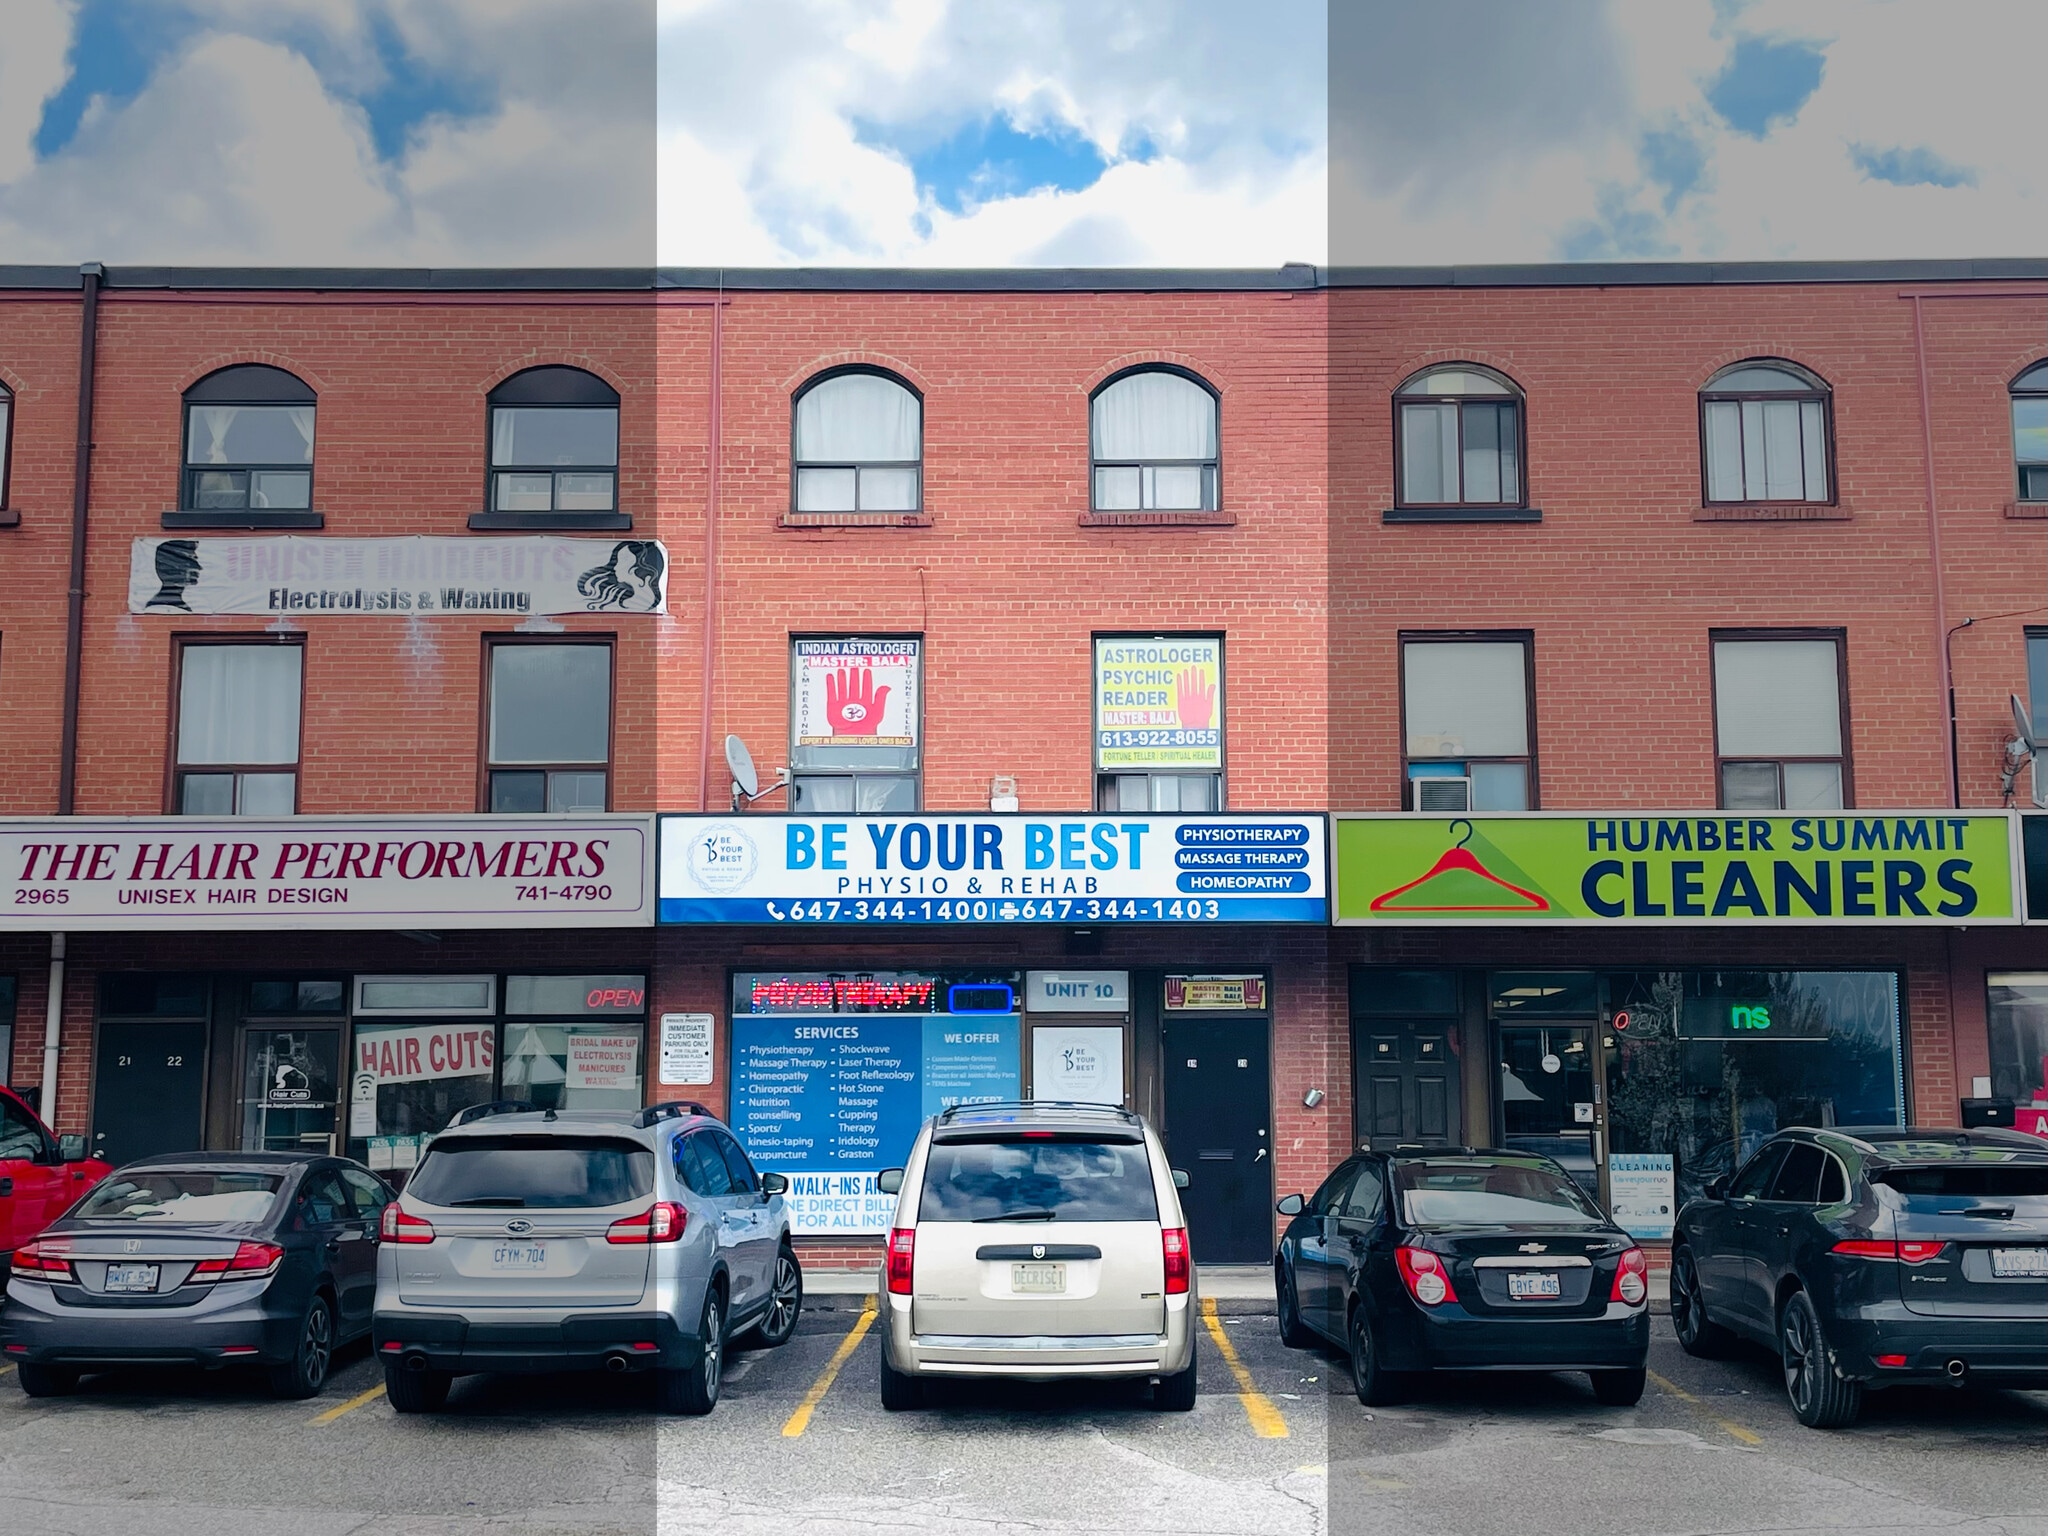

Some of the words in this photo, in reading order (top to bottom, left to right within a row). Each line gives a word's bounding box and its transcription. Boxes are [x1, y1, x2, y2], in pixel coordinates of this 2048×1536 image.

[227, 545, 364, 582] UNISEX
[378, 544, 575, 583] HAIRCUTS
[269, 587, 412, 611] Electrolysis
[417, 592, 434, 609] &
[440, 587, 531, 612] Waxing
[801, 643, 839, 655] INDIAN
[842, 643, 914, 655] ASTROLOGER
[810, 656, 868, 667] MASTER:
[871, 656, 907, 667] BALA
[1104, 648, 1213, 663] ASTROLOGER
[1103, 670, 1173, 685] PSYCHIC
[1103, 691, 1168, 706] READER
[1105, 711, 1147, 725] MASTER:
[1149, 711, 1175, 724] BALA
[1101, 730, 1217, 747] 613-922-8055
[1103, 751, 1131, 761] FORTUNE
[1134, 751, 1155, 761] TELLER
[1193, 750, 1216, 760] HEALER
[720, 836, 731, 844] BE
[1183, 828, 1303, 843] PHYSIOTHERAPY
[1588, 820, 1775, 852] HUMBER
[1791, 819, 1969, 851] SUMMIT
[786, 823, 848, 870] BE
[866, 822, 1004, 871] YOUR
[1025, 822, 1150, 871] BEST
[18, 843, 120, 881] THE
[127, 842, 259, 880] HAIR
[270, 839, 609, 880] PERFORMERS
[1179, 852, 1242, 865] MASSAGE
[1244, 852, 1304, 865] THERAPY
[838, 877, 948, 895] PHYSIO
[967, 877, 982, 894] &
[1002, 877, 1098, 894] REHAB
[1191, 876, 1294, 890] HOMEOPATHY
[1580, 858, 1978, 919] CLEANERS
[15, 889, 69, 904] 2965
[118, 888, 197, 905] UNISEX
[207, 888, 256, 904] HAIR
[267, 888, 348, 904] DESIGN
[515, 885, 612, 901] 741-4790
[790, 900, 987, 921] 647-344-1400
[1022, 899, 1220, 920] 647-344-1403
[1045, 983, 1089, 997] UNIT
[1094, 984, 1114, 998] 10
[586, 988, 645, 1008] OPEN
[794, 1026, 859, 1040] SERVICES
[944, 1033, 962, 1044] WE
[964, 1033, 1000, 1043] OFFER
[570, 1038, 598, 1047] BRIDAL
[601, 1039, 623, 1047] MAKE
[626, 1039, 637, 1047] UP
[361, 1037, 422, 1077] HAIR
[429, 1029, 494, 1072] CUTS
[749, 1045, 814, 1057] Physiotherapy
[839, 1044, 891, 1054] Shockwave
[118, 1055, 131, 1066] 21
[167, 1055, 182, 1066] 22
[574, 1051, 632, 1060] ELECTROLYSIS
[578, 1064, 626, 1073] MANICURES
[749, 1058, 789, 1069] Massage
[790, 1058, 828, 1069] Therapy
[839, 1057, 863, 1067] Laser
[864, 1057, 901, 1068] Therapy
[749, 1071, 809, 1082] Homeopathy
[838, 1070, 860, 1080] Foot
[861, 1070, 915, 1081] Reflexology
[748, 1084, 805, 1095] Chiropractic
[838, 1084, 856, 1093] Hot
[857, 1084, 885, 1093] Stone
[748, 1097, 790, 1107] Nutrition
[838, 1097, 879, 1108] Massage
[941, 1096, 958, 1107] WE
[748, 1110, 801, 1121] counselling
[838, 1110, 878, 1121] Cupping
[748, 1124, 782, 1135] Sports/
[838, 1122, 876, 1134] Therapy
[747, 1136, 814, 1148] kinesio-taping
[838, 1136, 879, 1147] Iridology
[748, 1150, 808, 1161] Acupuncture
[838, 1149, 874, 1159] Graston
[1610, 1163, 1672, 1171] CLEANING
[792, 1176, 861, 1195] WALK-INS
[809, 1199, 860, 1212] DIRECT
[865, 1199, 893, 1212] BILL
[797, 1214, 828, 1227] FOR
[831, 1214, 858, 1227] ALL
[862, 1214, 888, 1227] INS
[495, 1249, 520, 1262] CFYM
[526, 1249, 545, 1262] 704
[1541, 1280, 1559, 1293] 496
